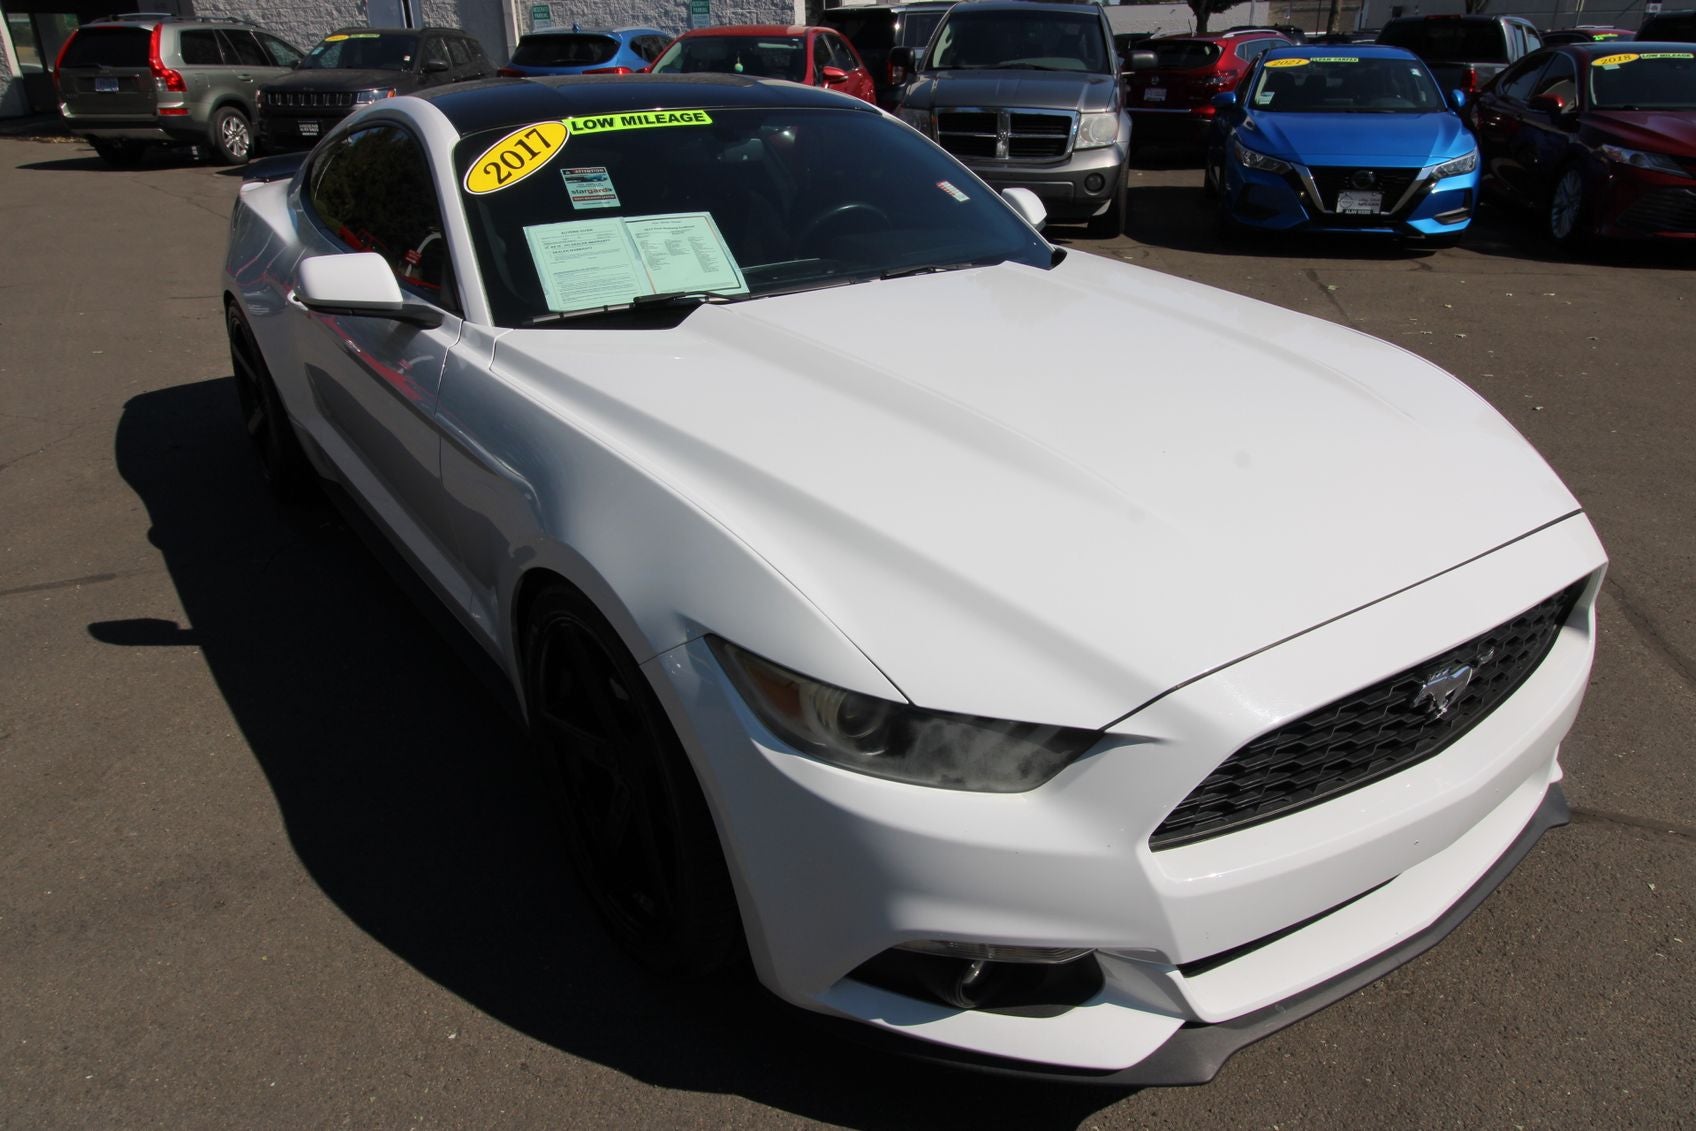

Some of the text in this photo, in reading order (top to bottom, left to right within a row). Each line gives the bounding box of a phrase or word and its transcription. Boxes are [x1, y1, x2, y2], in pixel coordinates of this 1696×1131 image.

[1601, 55, 1632, 64] 2018
[572, 112, 706, 132] LOW MILEAGE
[483, 128, 551, 185] 2017
